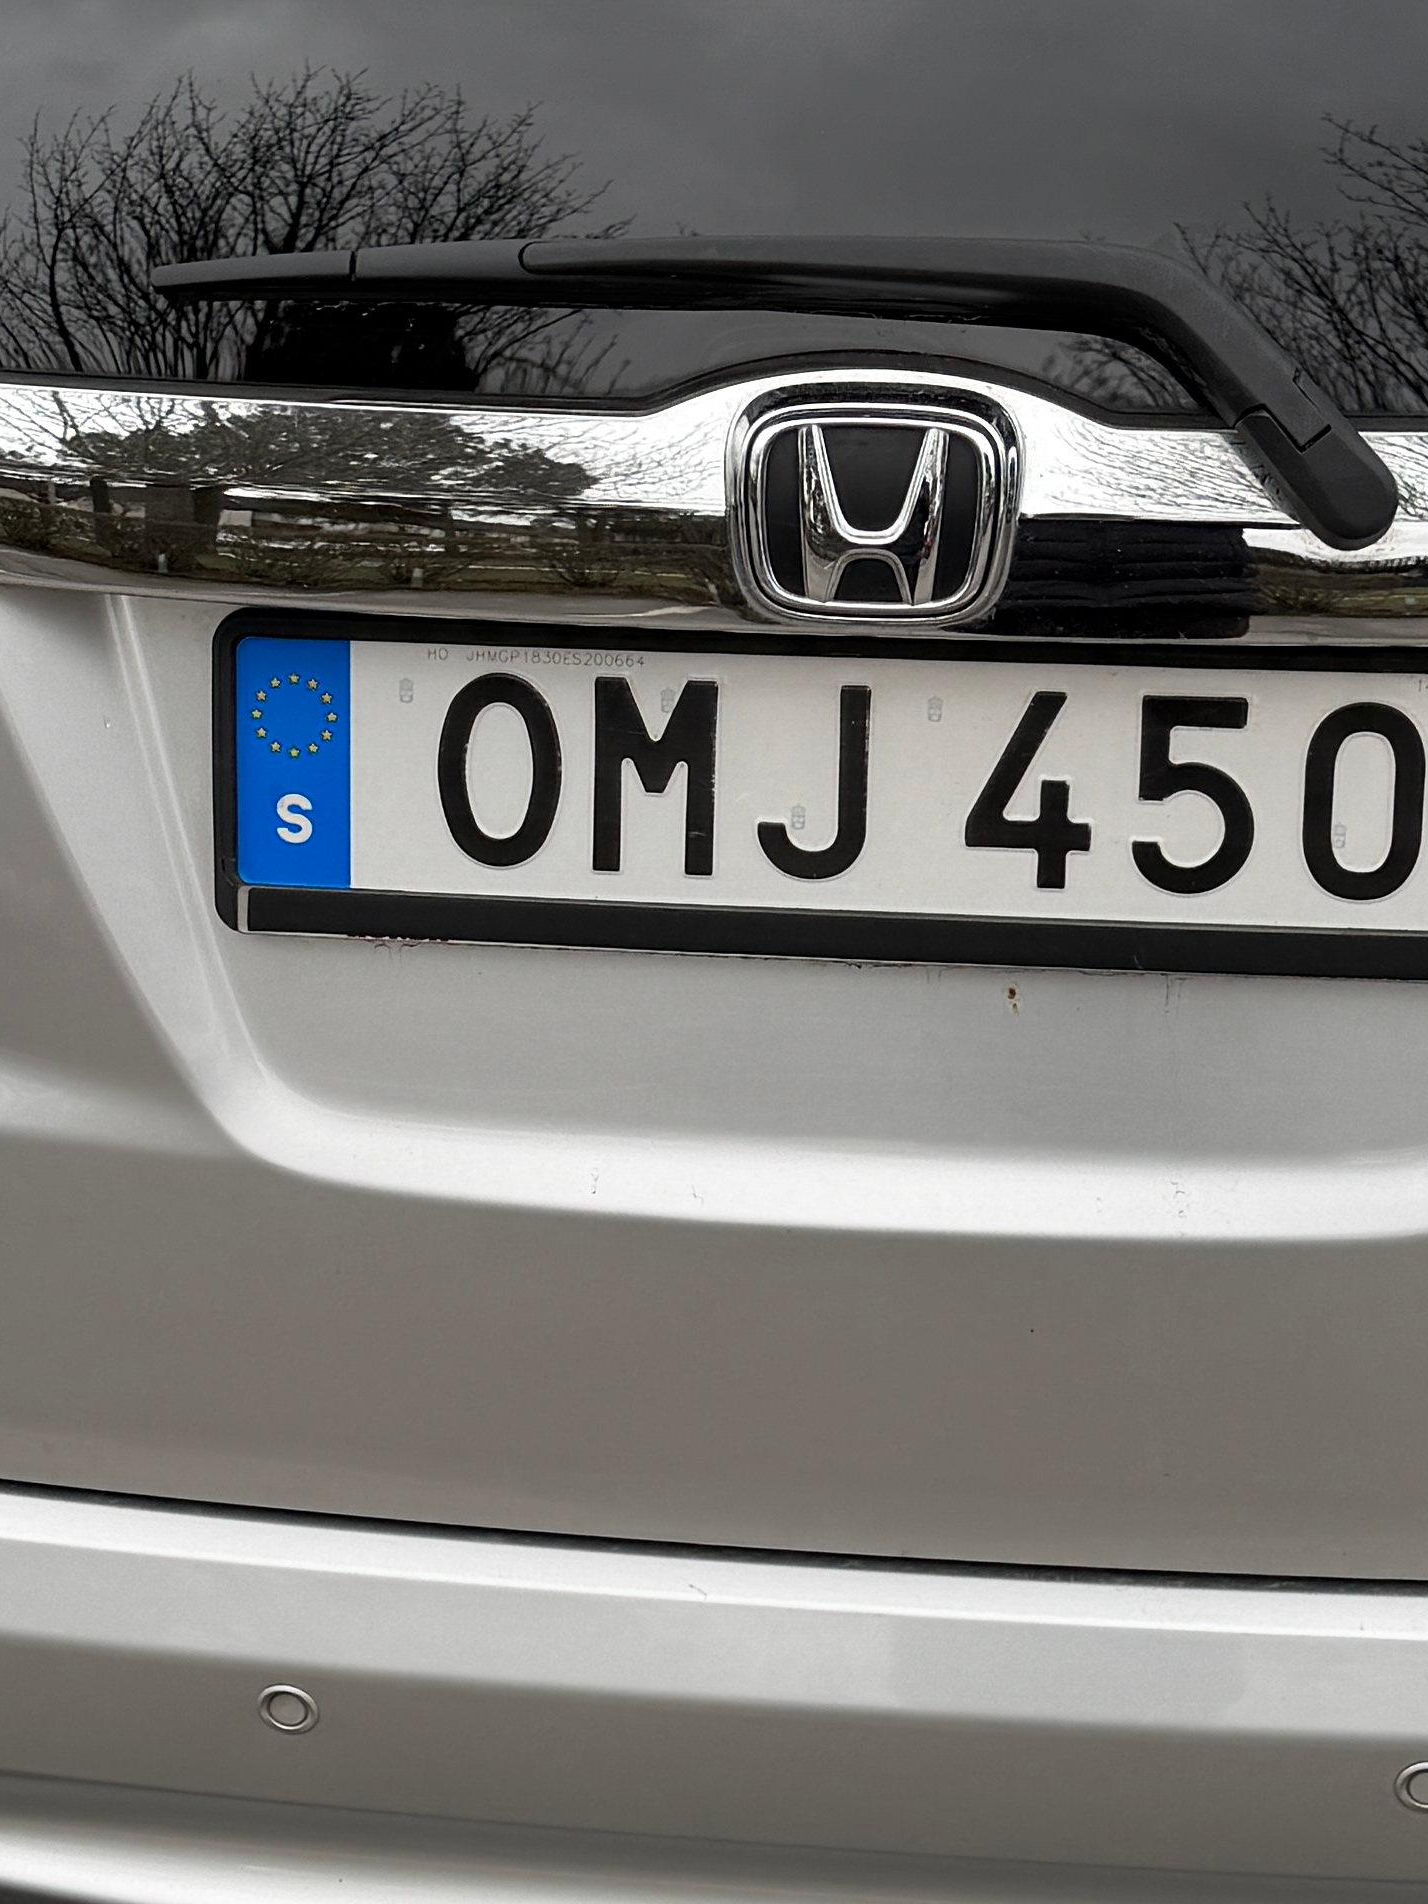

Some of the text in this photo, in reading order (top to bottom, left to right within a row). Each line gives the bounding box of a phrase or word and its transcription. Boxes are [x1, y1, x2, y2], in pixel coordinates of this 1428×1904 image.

[275, 793, 313, 845] S
[437, 672, 1427, 901] OMJ 450
